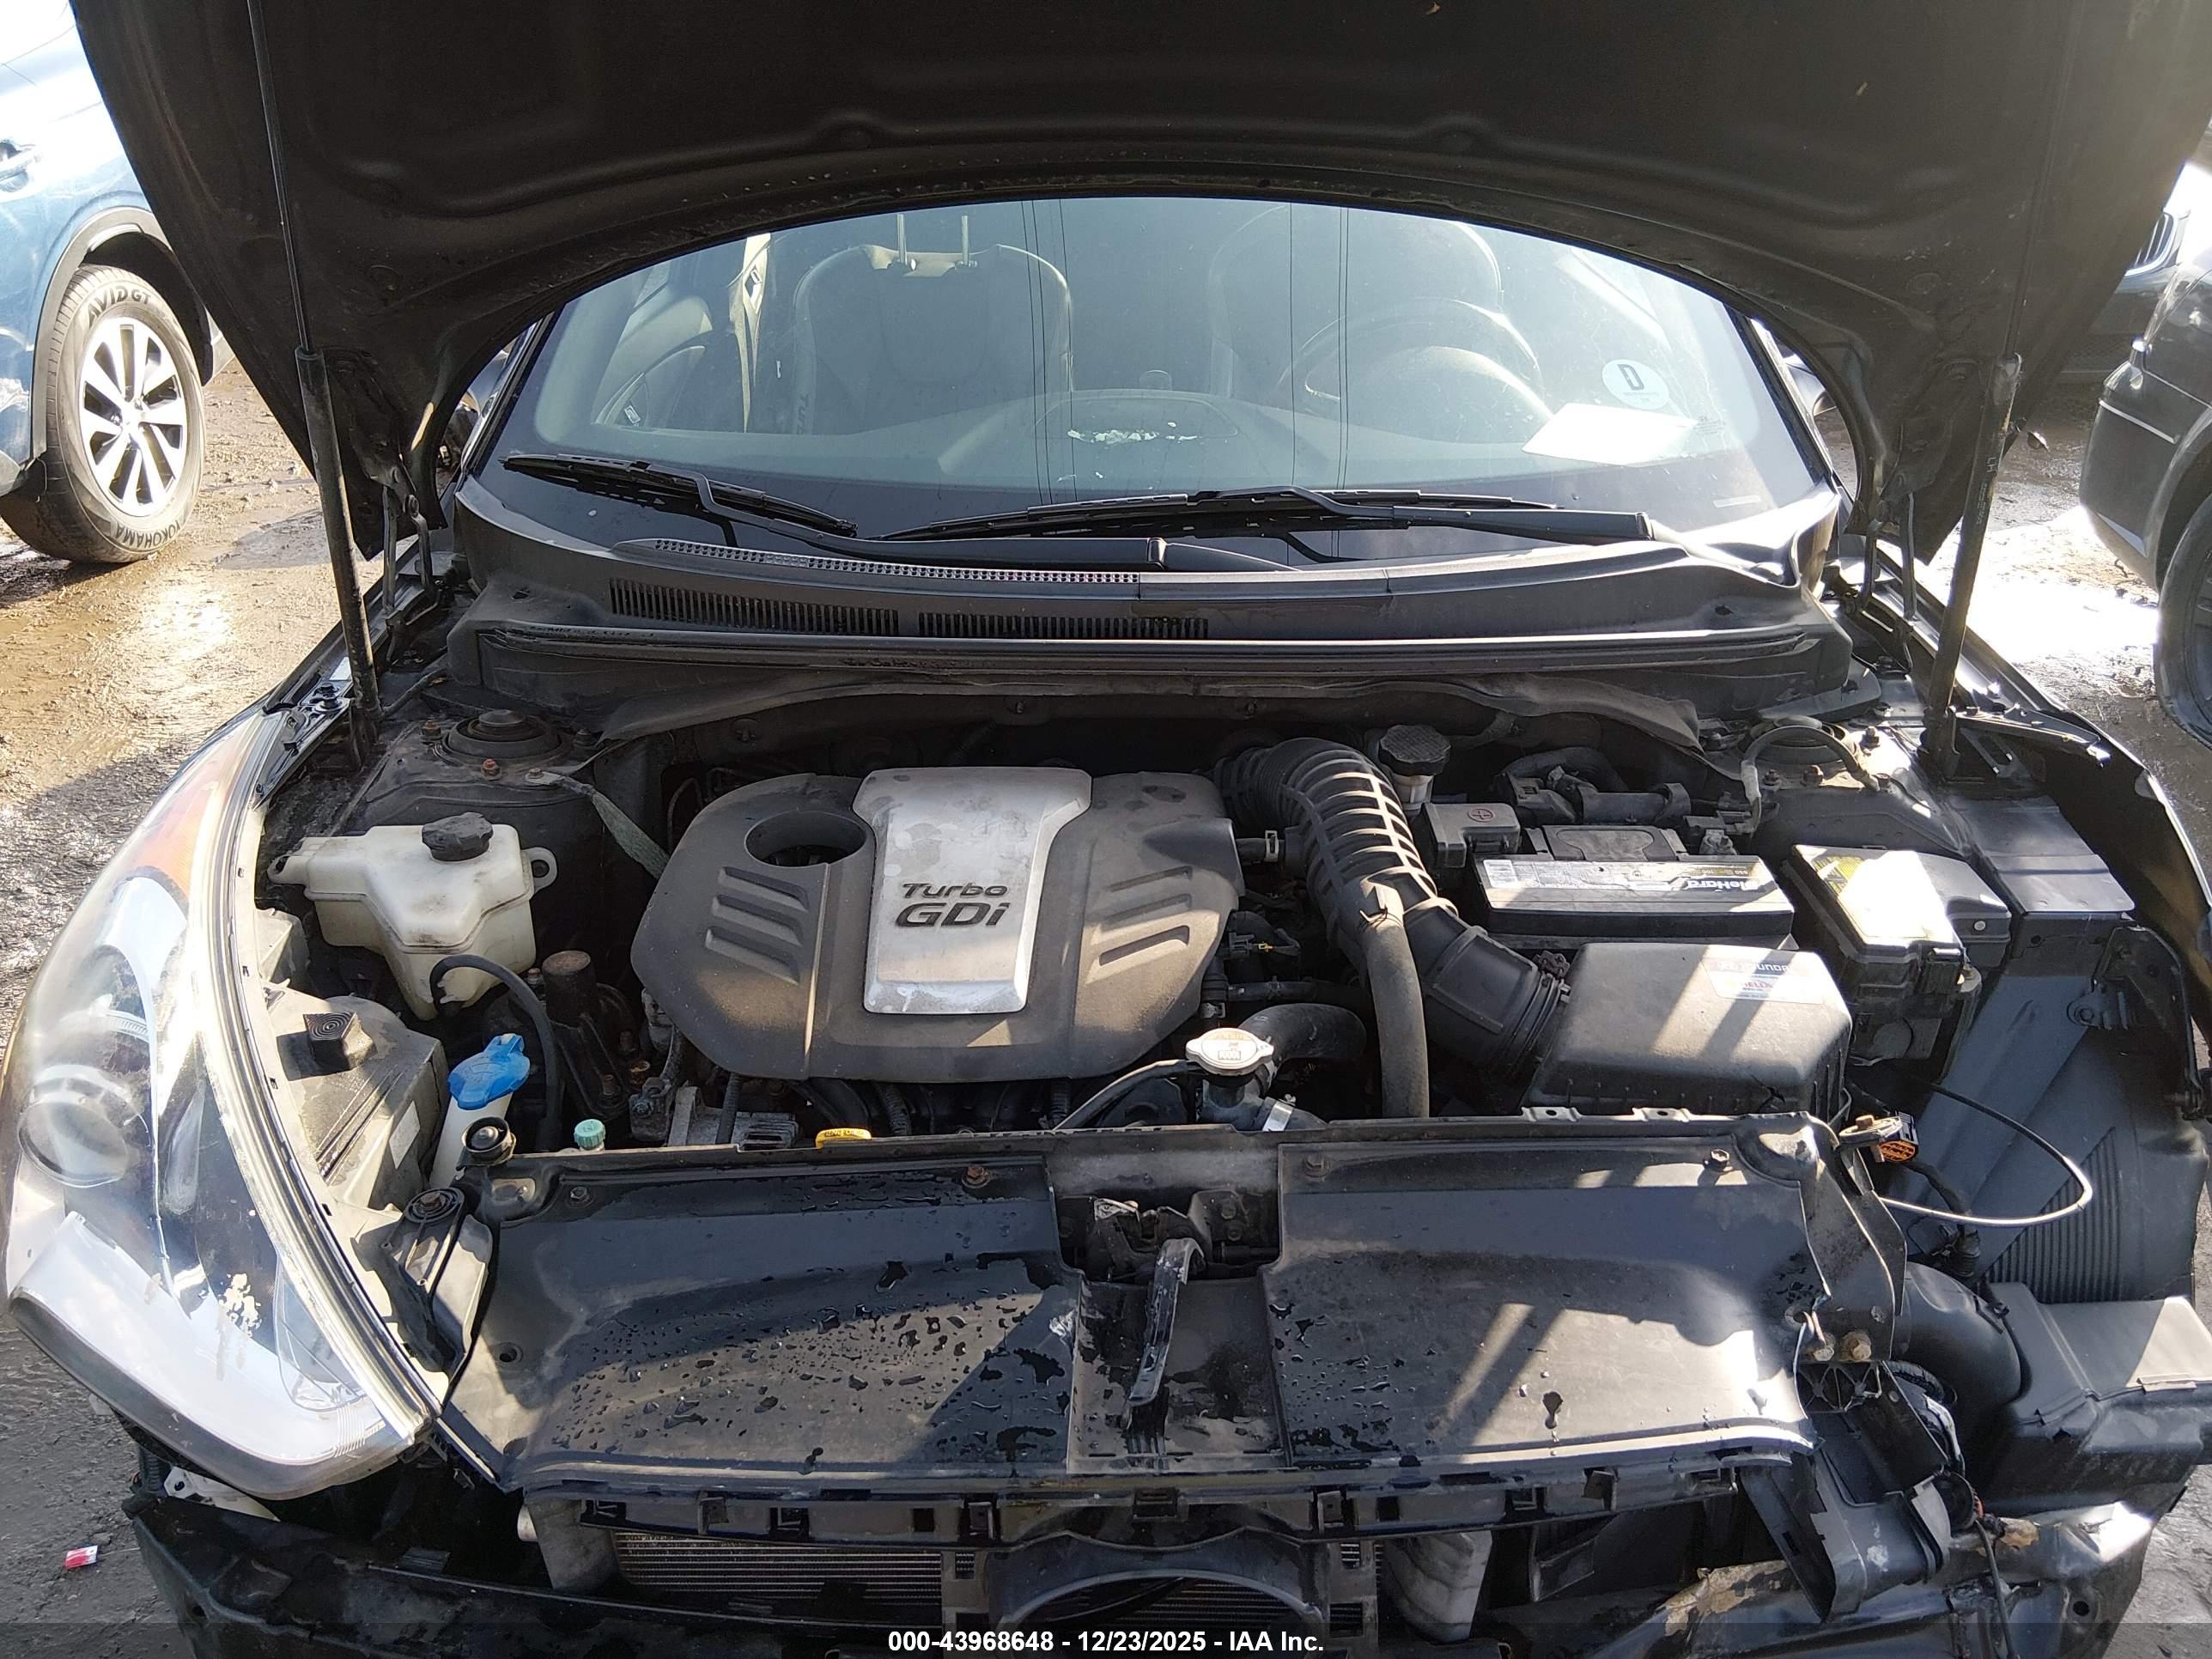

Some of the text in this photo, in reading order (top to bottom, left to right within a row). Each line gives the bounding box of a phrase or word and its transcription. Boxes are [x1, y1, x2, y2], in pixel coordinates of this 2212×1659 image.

[88, 286, 152, 327] AVID GT
[1616, 363, 1645, 391] D
[115, 519, 181, 549] YOKOHAMA
[902, 882, 1008, 899] Turbo
[895, 902, 1011, 927] GDi
